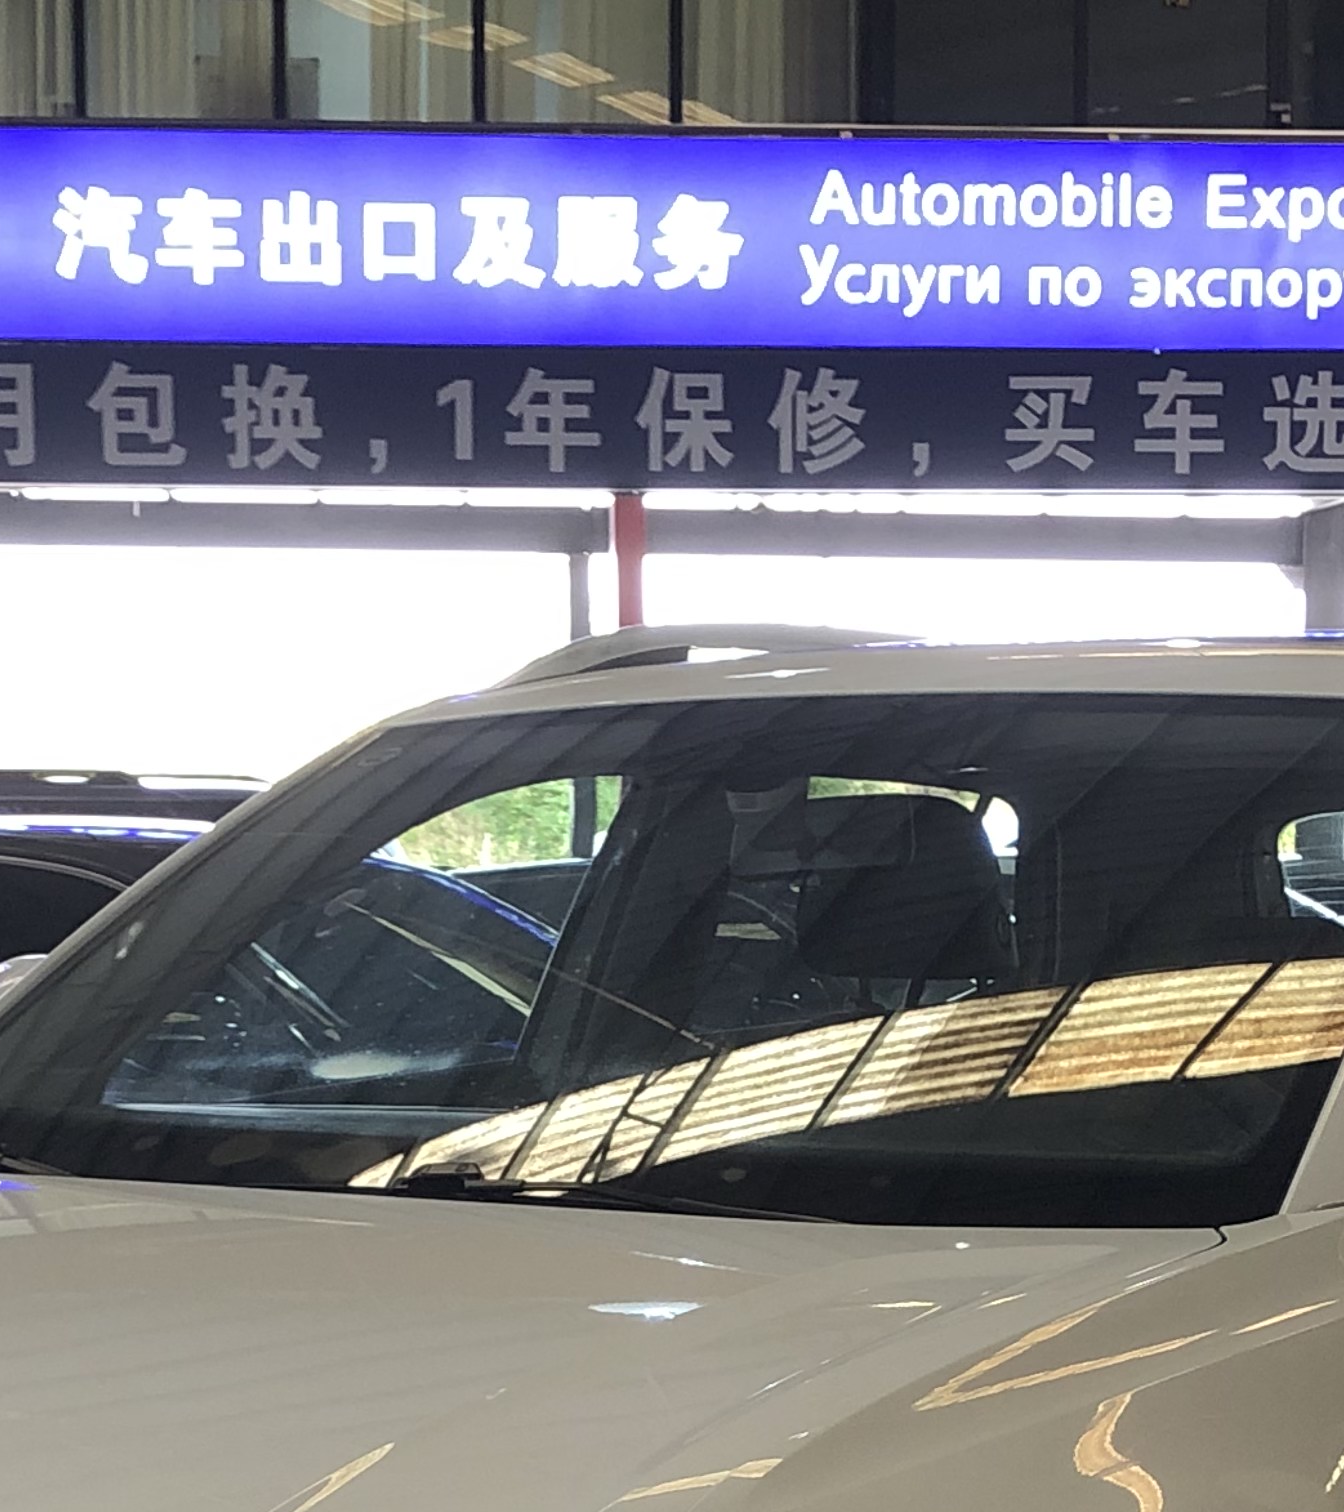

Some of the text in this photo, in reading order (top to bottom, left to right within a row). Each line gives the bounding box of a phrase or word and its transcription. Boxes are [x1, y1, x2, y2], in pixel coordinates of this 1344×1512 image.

[810, 169, 1173, 228] Automobile
[53, 186, 744, 289] 汽车出口及服务
[799, 244, 1001, 317] Услуги
[1029, 265, 1103, 307] по
